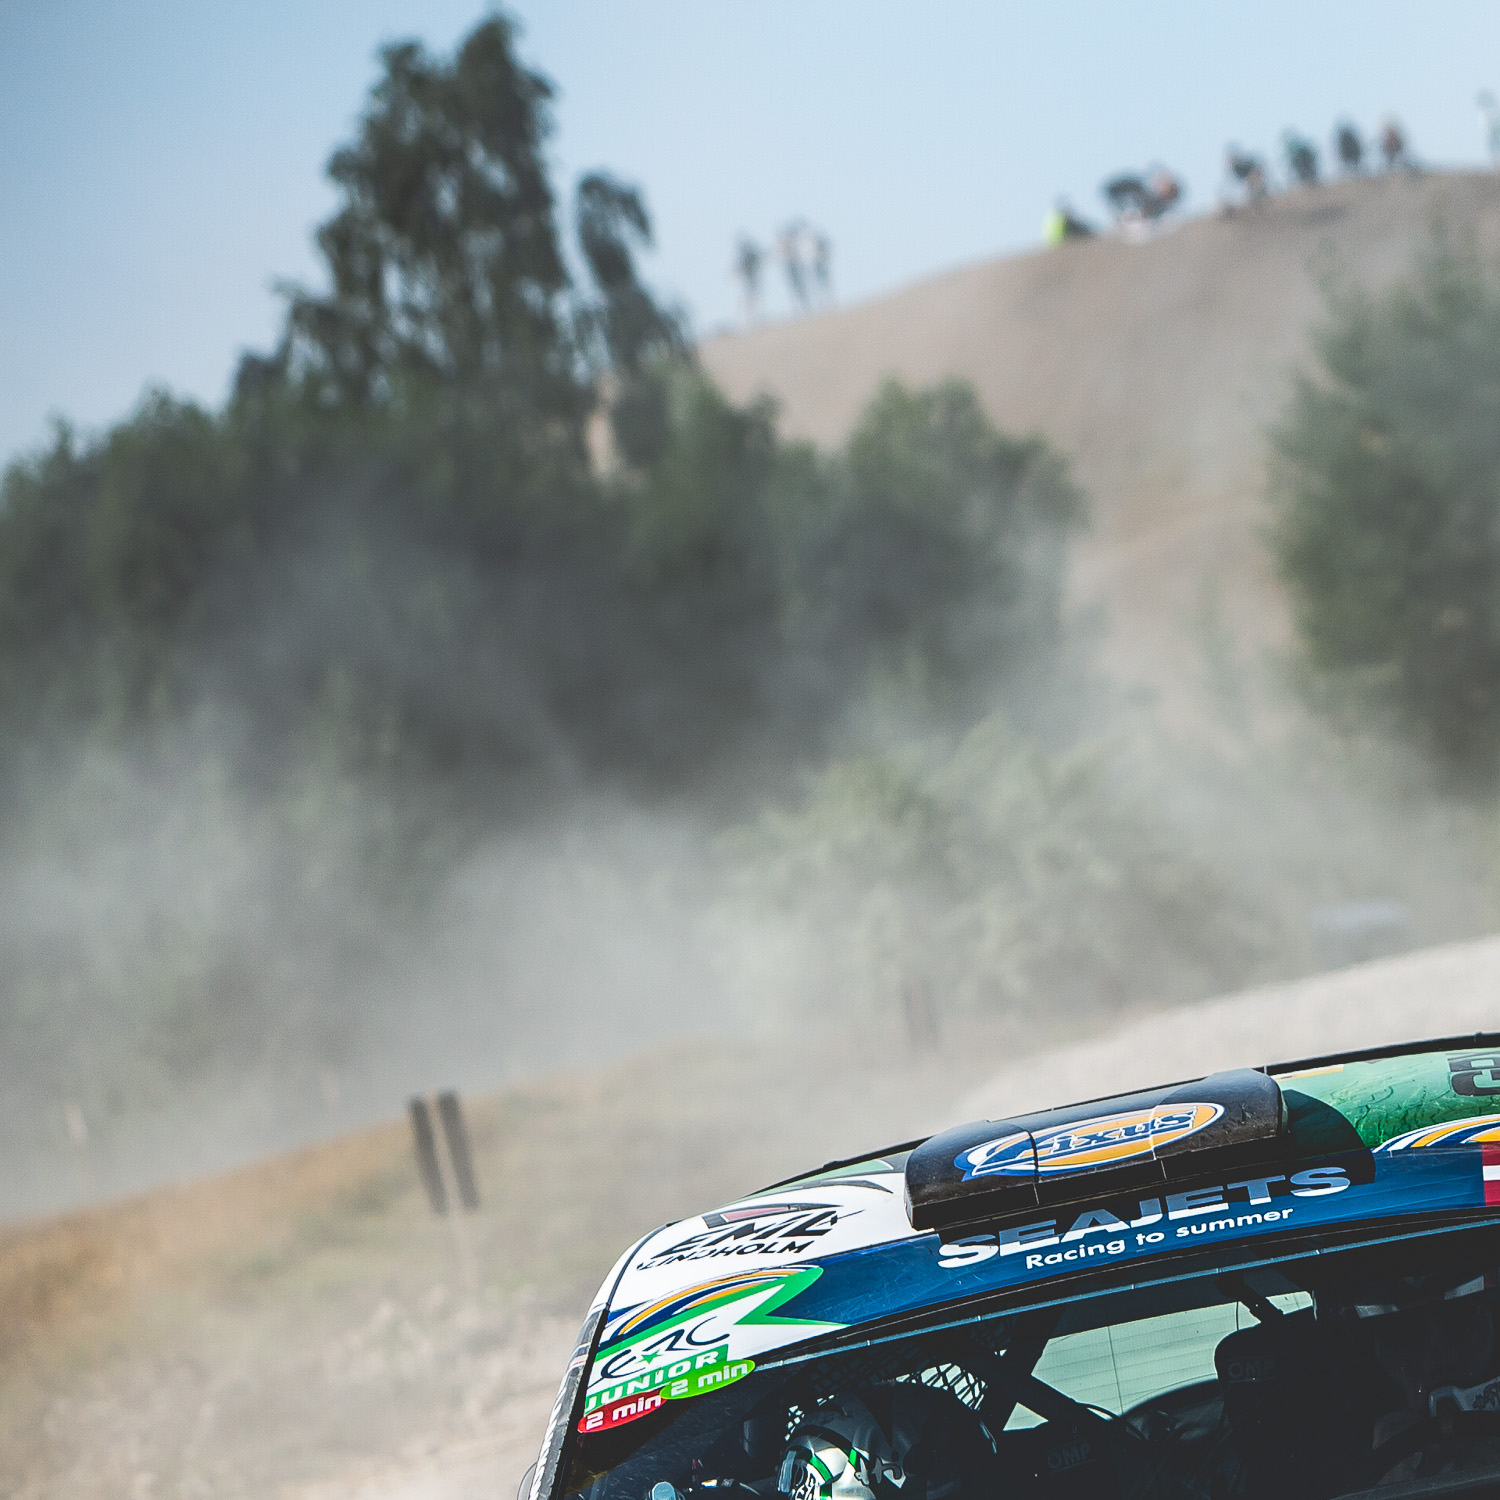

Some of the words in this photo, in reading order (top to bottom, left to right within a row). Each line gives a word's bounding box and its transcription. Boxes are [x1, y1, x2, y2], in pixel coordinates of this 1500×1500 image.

[938, 1166, 1351, 1268] SEAJETS
[1026, 1237, 1126, 1270] Racing
[1137, 1230, 1165, 1247] to
[1176, 1205, 1294, 1239] summer
[585, 1351, 719, 1412] JUNIOR
[670, 1378, 689, 1397] 2
[697, 1363, 748, 1388] min
[585, 1411, 604, 1431] 2
[611, 1396, 662, 1422] min
